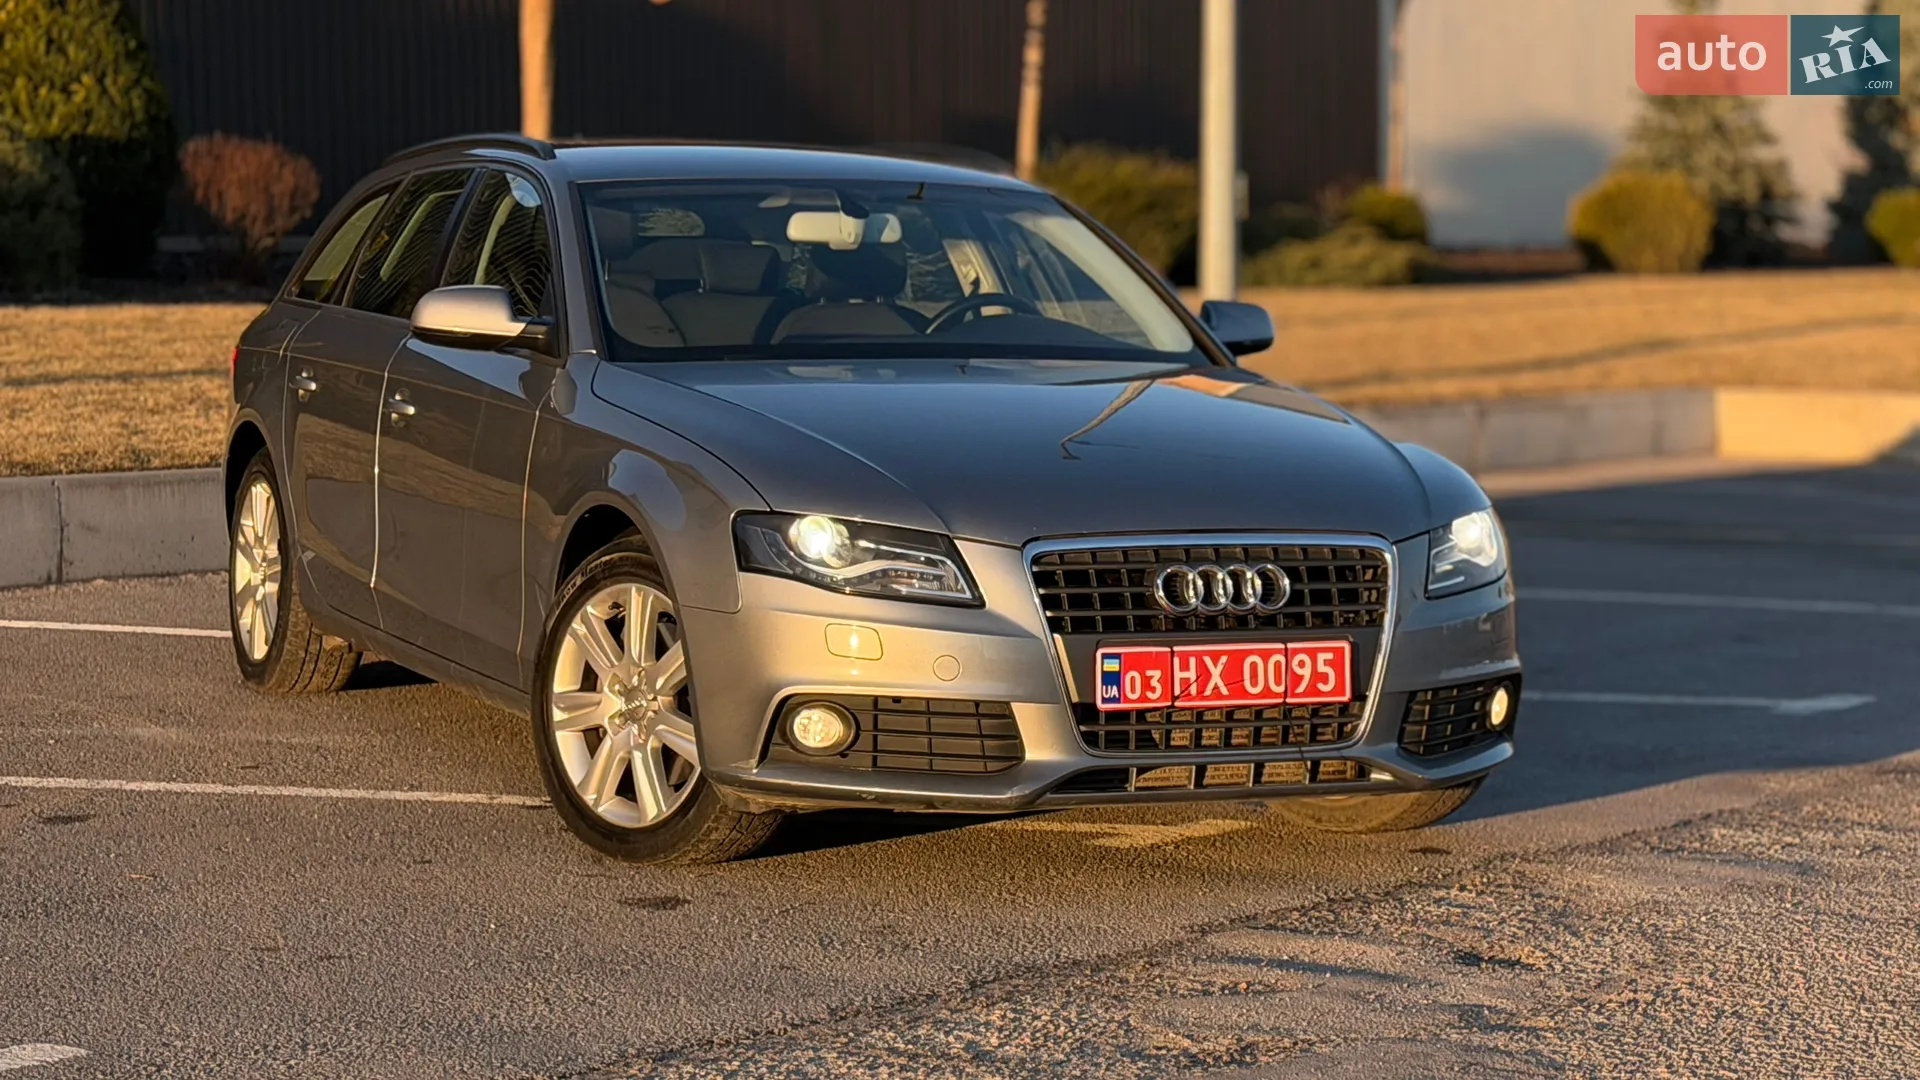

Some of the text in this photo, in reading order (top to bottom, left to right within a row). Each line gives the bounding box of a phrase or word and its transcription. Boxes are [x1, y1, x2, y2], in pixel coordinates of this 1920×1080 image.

[1124, 652, 1336, 700] 03 HX 0095
[1102, 685, 1119, 699] UA
